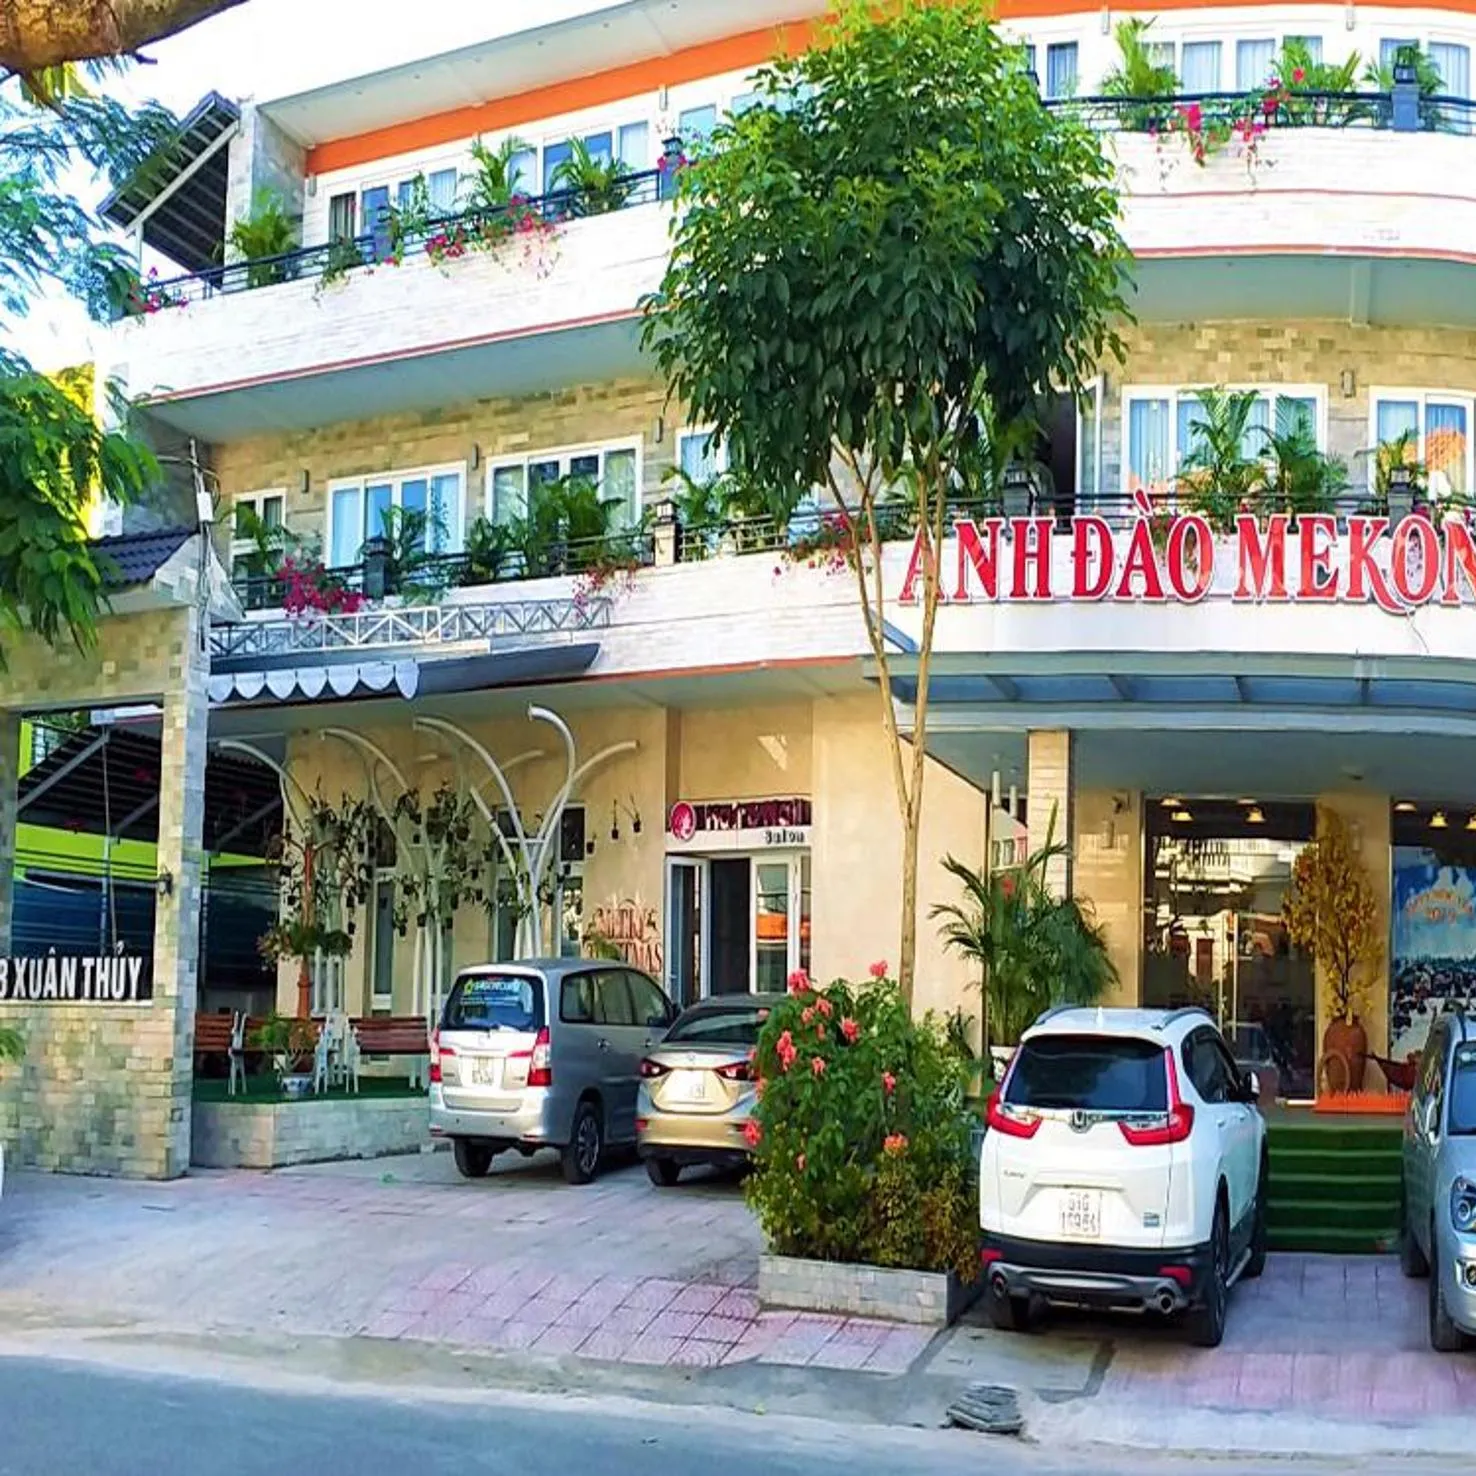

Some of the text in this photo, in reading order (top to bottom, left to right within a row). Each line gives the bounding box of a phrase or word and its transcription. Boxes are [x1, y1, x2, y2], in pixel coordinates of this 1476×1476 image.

[898, 515, 1057, 605] ANH
[1070, 488, 1216, 604] ĐÀO
[12, 946, 78, 999] XUÂN
[82, 939, 143, 999] THỦY
